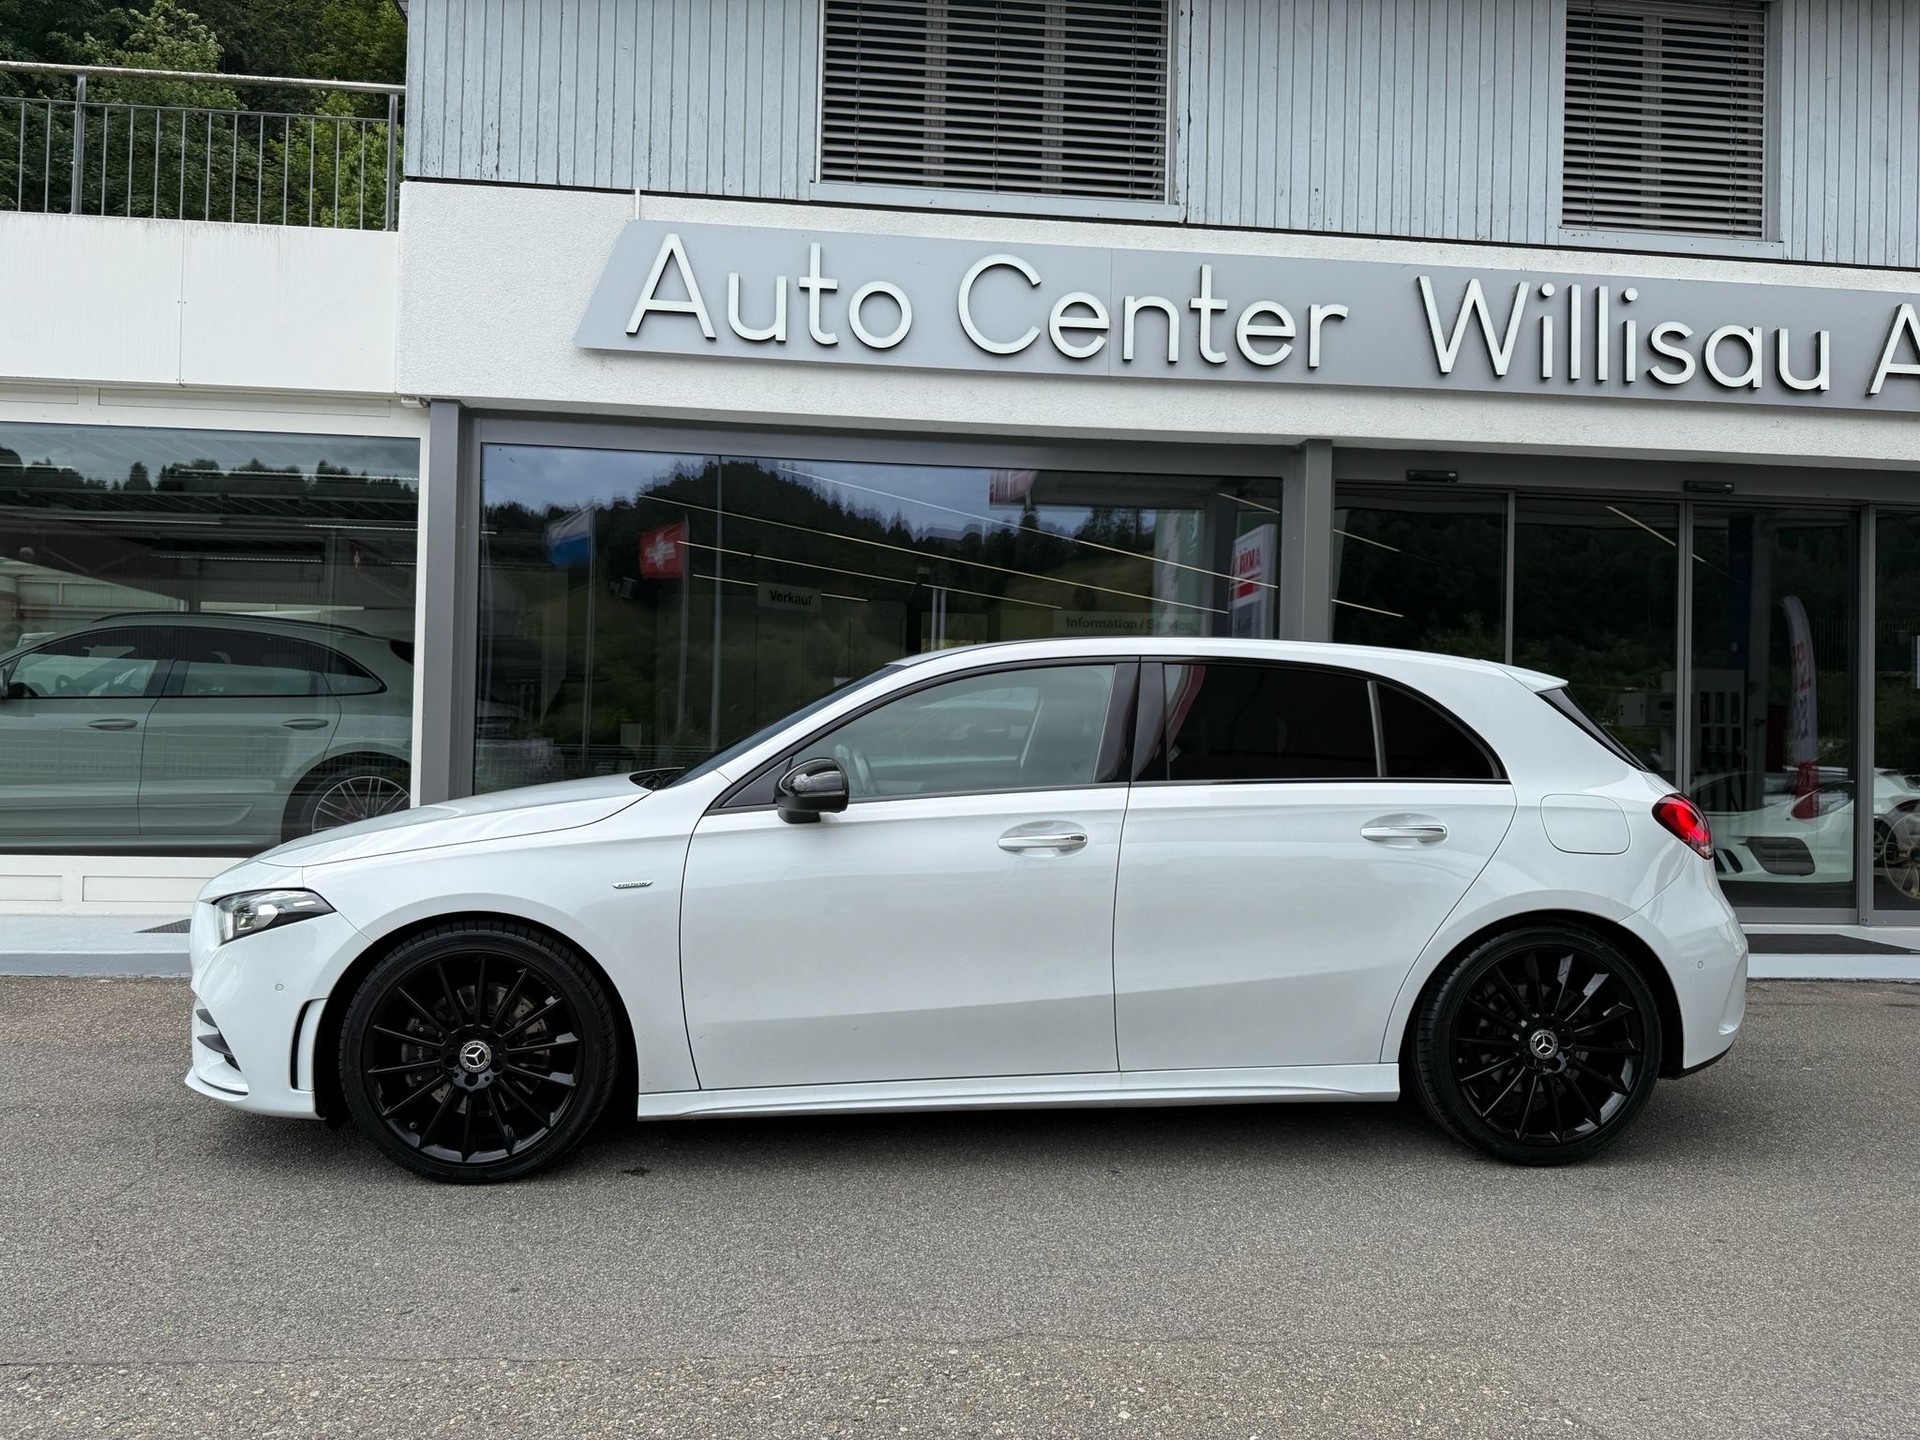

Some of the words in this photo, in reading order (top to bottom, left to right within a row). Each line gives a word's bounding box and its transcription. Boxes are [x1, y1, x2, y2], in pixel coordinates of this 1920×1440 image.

[626, 235, 913, 350] Auto
[957, 255, 1349, 369] Center
[1416, 276, 1831, 391] Willisau
[1867, 303, 1920, 397] A
[769, 590, 812, 606] Verkauf
[1066, 616, 1138, 630] Information
